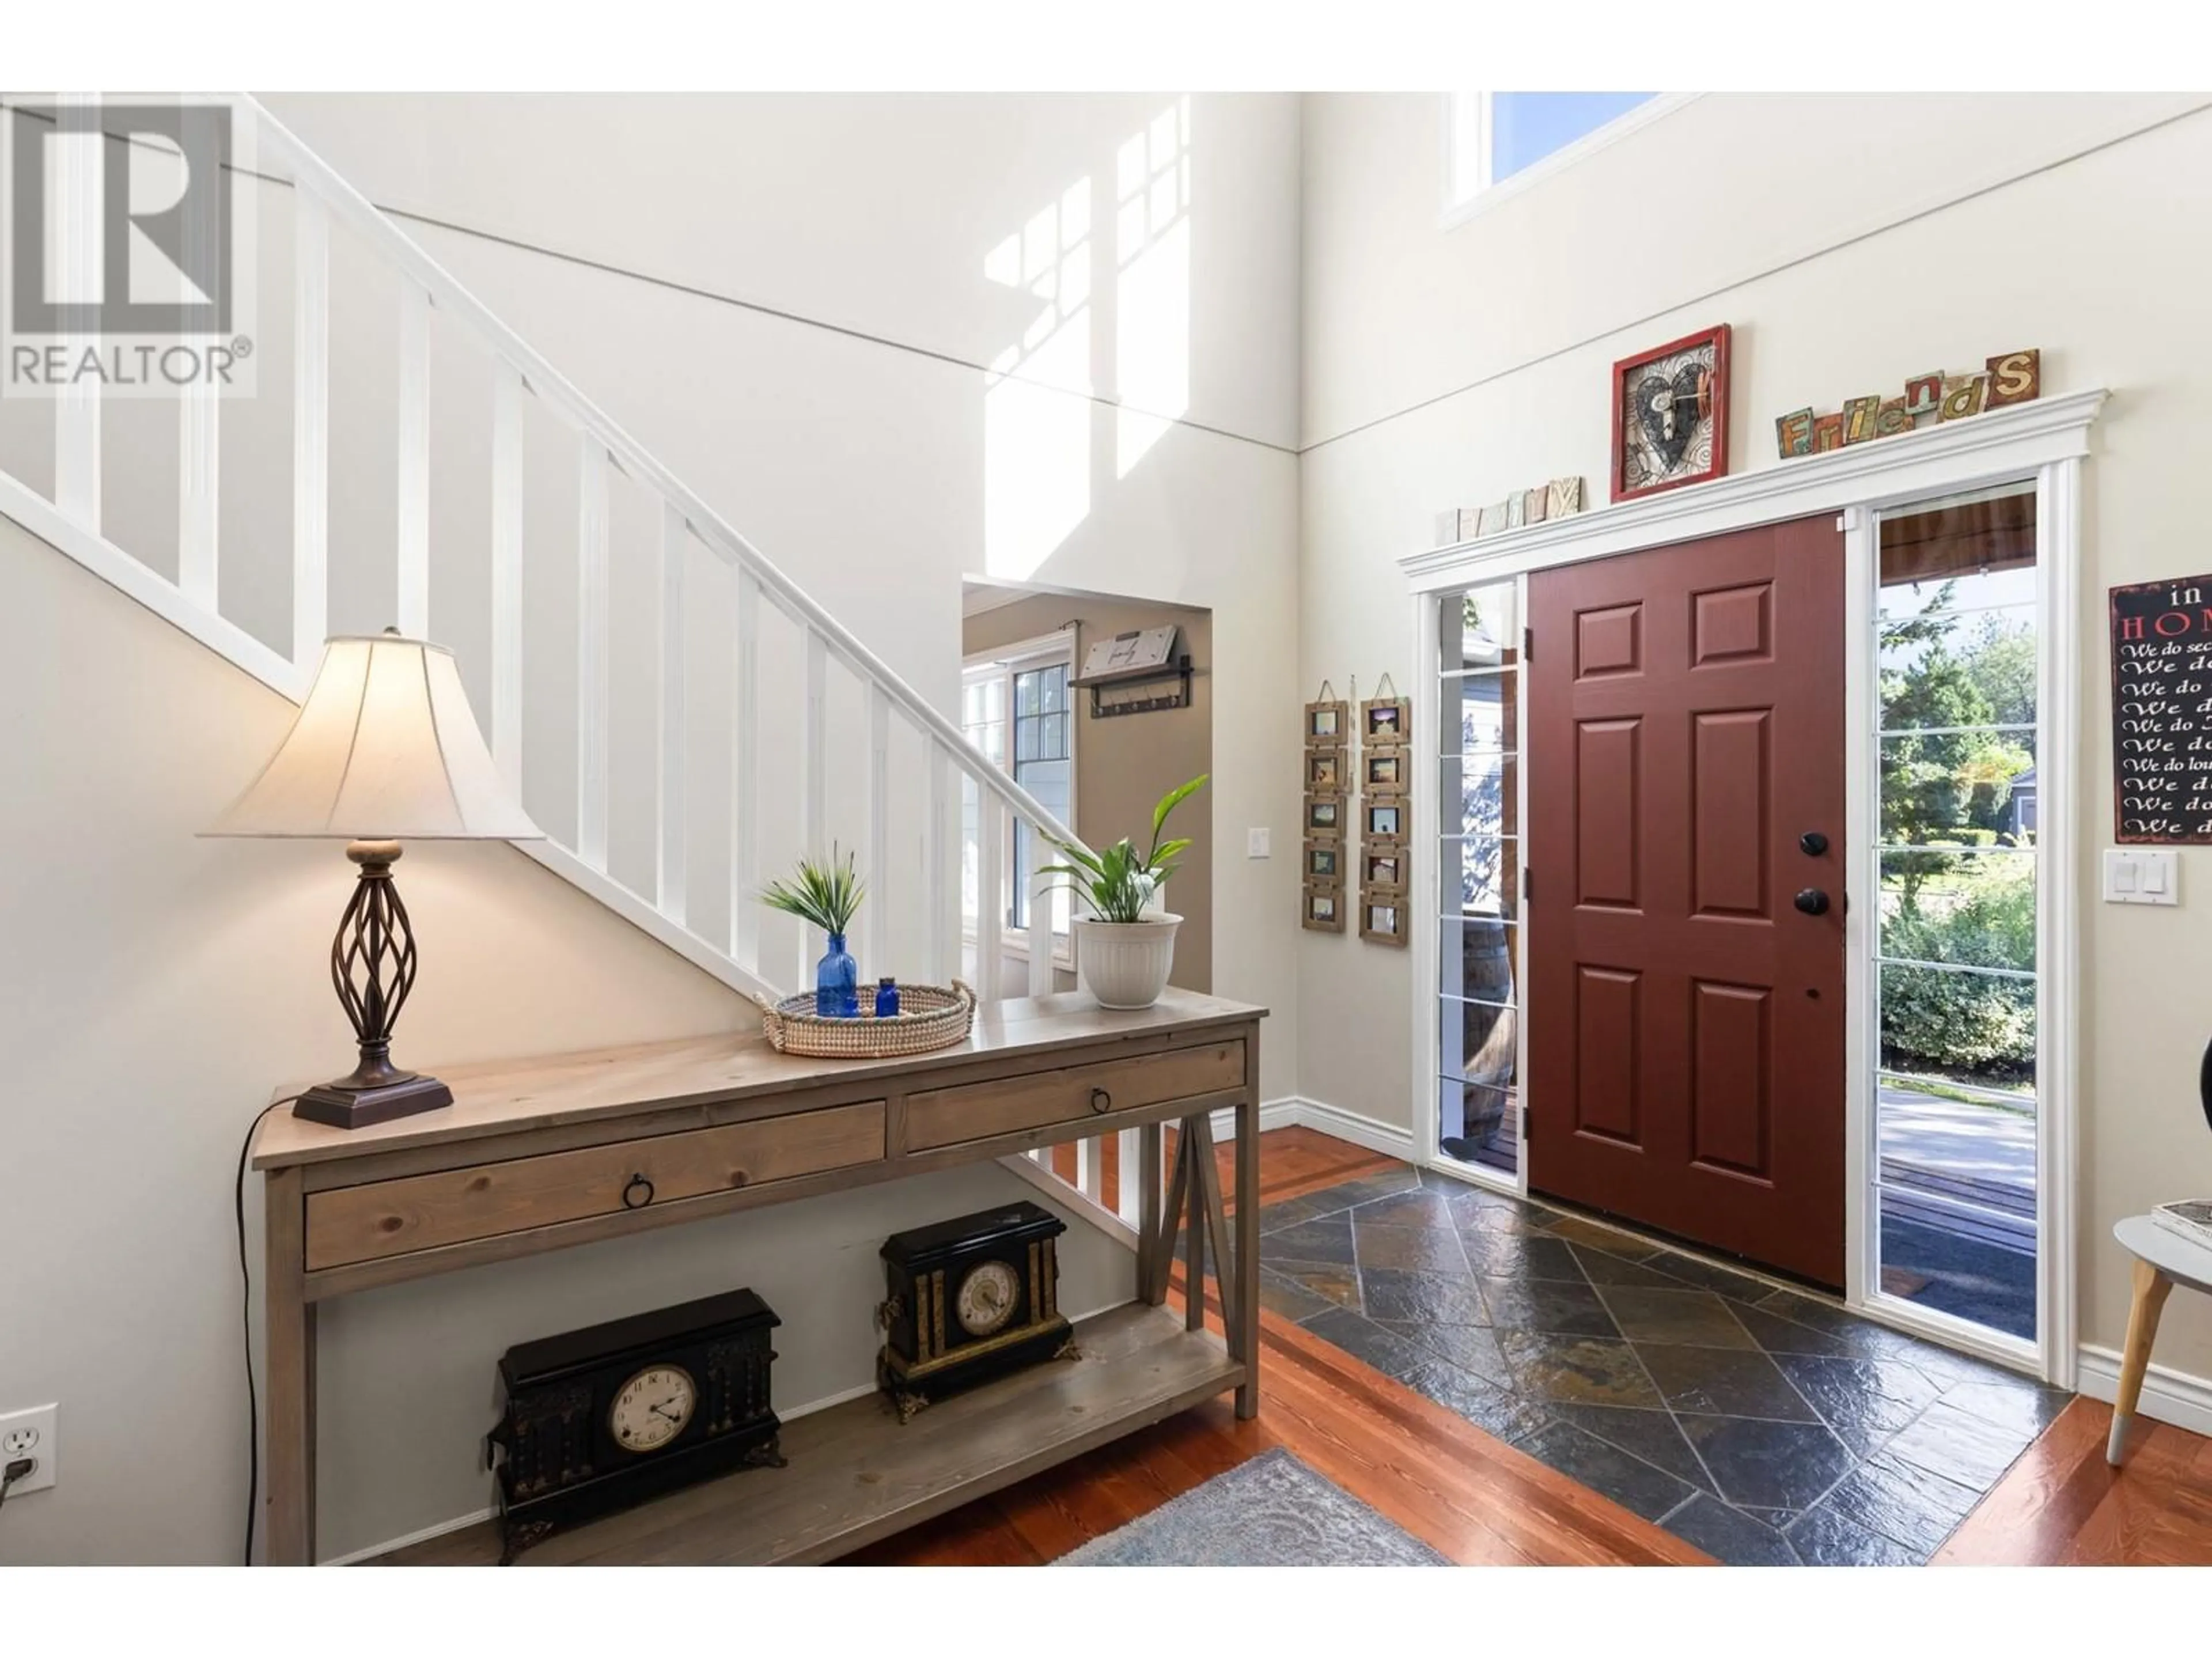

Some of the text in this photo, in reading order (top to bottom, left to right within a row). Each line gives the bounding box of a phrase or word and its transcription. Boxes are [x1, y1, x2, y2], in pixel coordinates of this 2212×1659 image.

[2170, 584, 2201, 605] in
[2120, 642, 2159, 658] We
[2162, 641, 2182, 656] do
[2121, 659, 2178, 675] We
[2122, 679, 2202, 696] We do
[2122, 700, 2183, 715] We
[2122, 719, 2164, 733] We
[2170, 717, 2194, 732] do
[2123, 738, 2176, 752] We
[2123, 757, 2161, 772] We
[2164, 757, 2184, 771] do
[2123, 777, 2179, 791] We
[2123, 796, 2212, 811] We do
[2124, 819, 2183, 833] We
